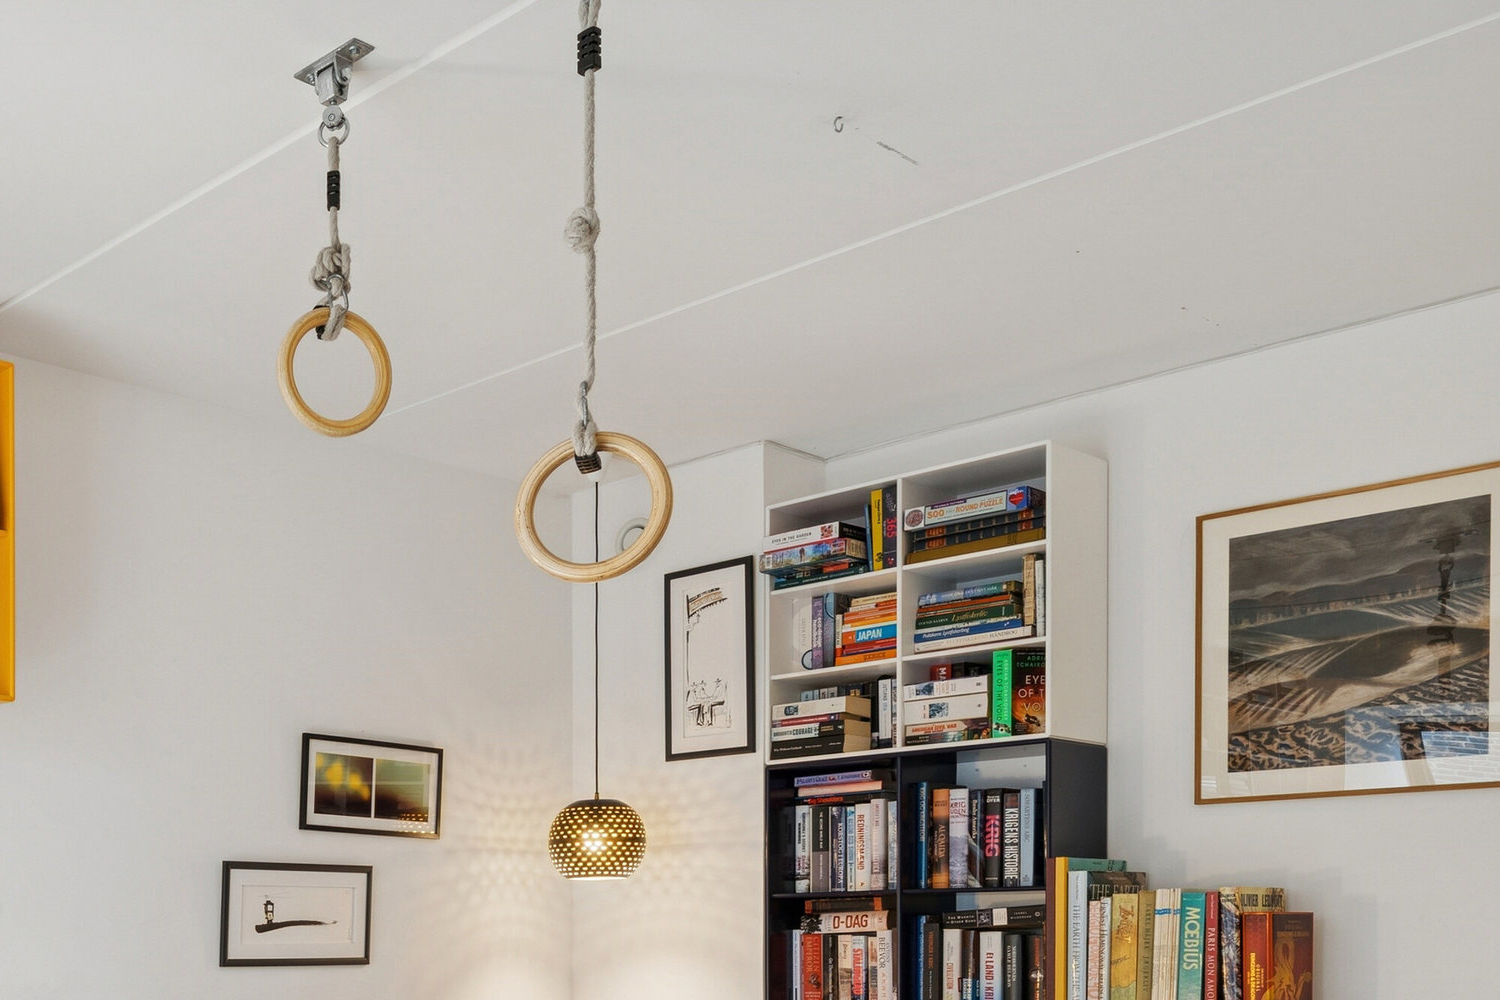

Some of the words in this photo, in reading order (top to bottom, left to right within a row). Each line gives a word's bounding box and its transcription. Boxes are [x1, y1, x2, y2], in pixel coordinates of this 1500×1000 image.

[928, 508, 945, 520] 500
[955, 503, 979, 513] ROUND
[980, 497, 1004, 509] PUZZLE
[856, 629, 883, 642] JAPAN
[1018, 688, 1035, 699] OF
[986, 814, 1001, 858] KRIG
[1005, 808, 1019, 845] KRIGENS
[857, 814, 866, 871] REDNINGSMÆND
[1004, 845, 1019, 881] HISTORIE
[833, 914, 869, 930] D-DAG
[1207, 927, 1216, 953] PARIS
[986, 960, 994, 981] LAND
[1207, 955, 1215, 978] MON
